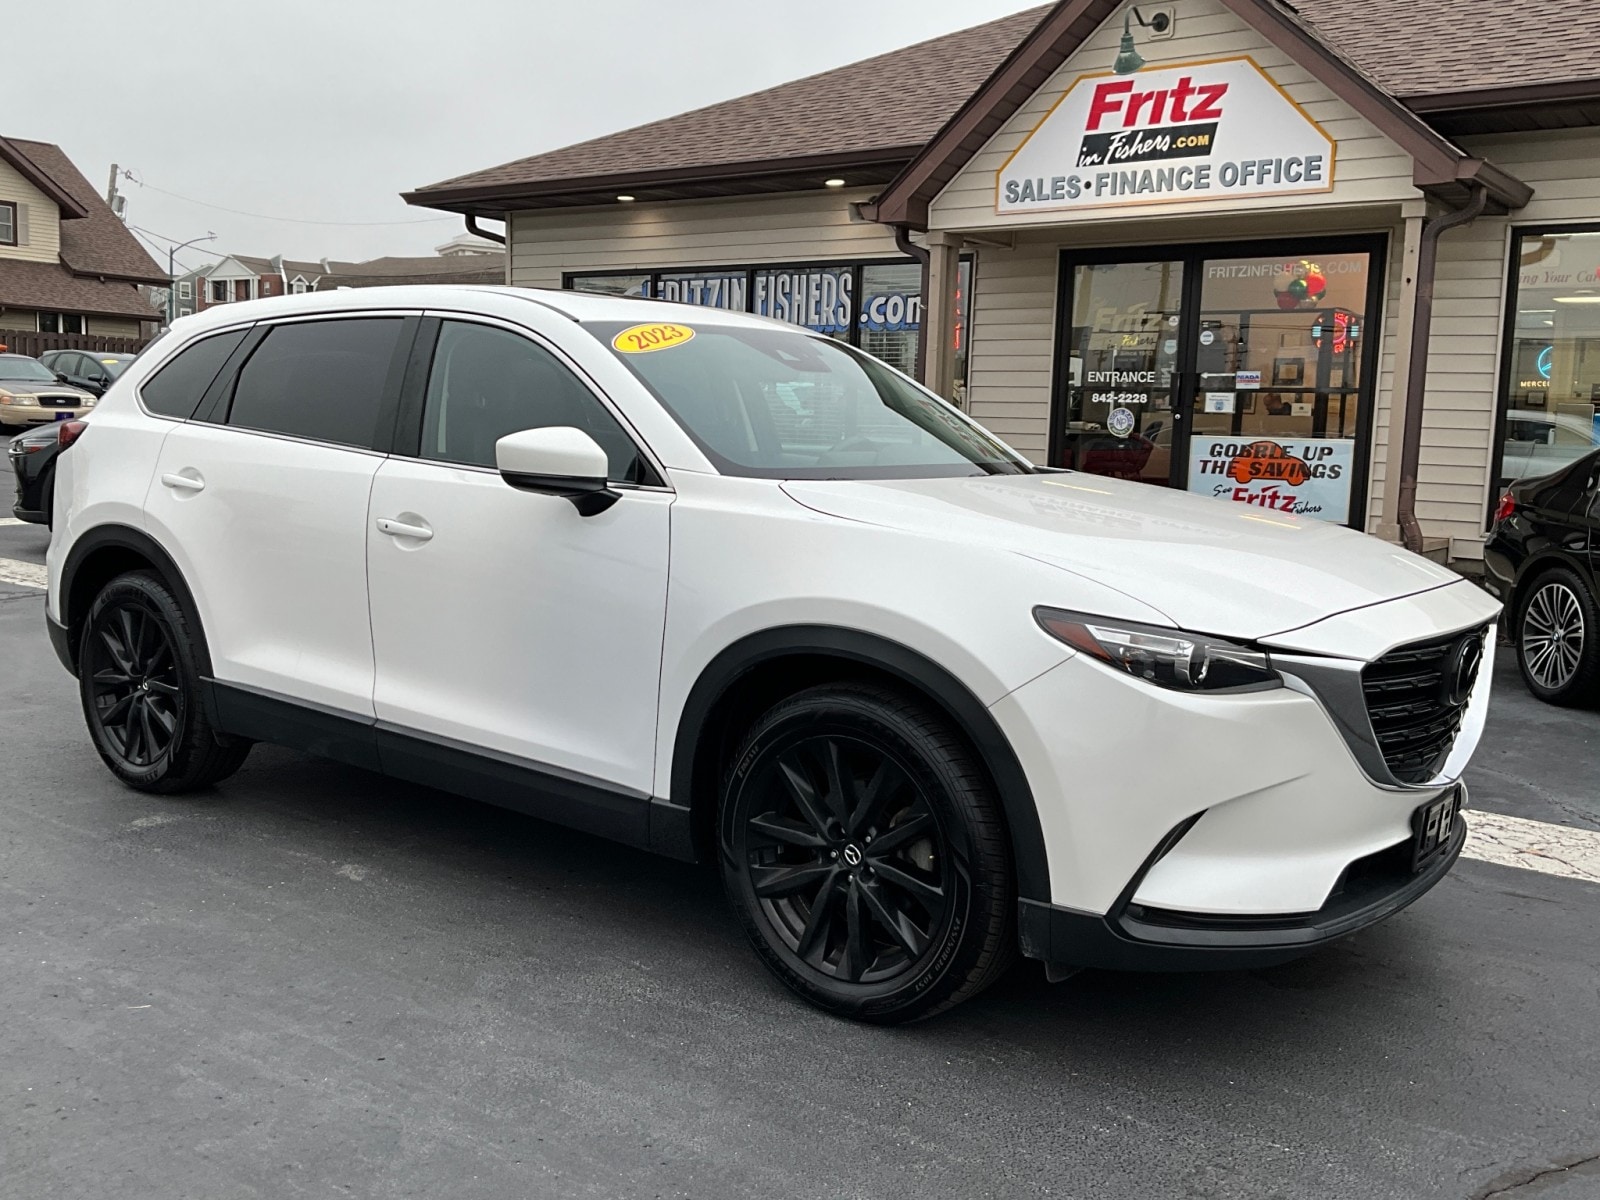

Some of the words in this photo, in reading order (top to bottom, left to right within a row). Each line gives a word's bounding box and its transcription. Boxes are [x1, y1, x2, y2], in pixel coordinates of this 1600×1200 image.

[1085, 76, 1229, 131] Fritz
[1079, 146, 1101, 166] in
[1005, 174, 1081, 203] SALES
[1095, 164, 1211, 197] FINANCE
[1218, 155, 1323, 187] OFFICE
[1208, 260, 1361, 279] FRITZINFISHES.COM
[1543, 270, 1572, 284] Your
[628, 325, 683, 349] 2023
[1088, 371, 1156, 383] ENTRANCE
[1092, 393, 1148, 404] 842-2228
[1209, 443, 1294, 460] GOBBLE
[1302, 446, 1334, 461] UP
[1200, 459, 1240, 475] THE
[1248, 461, 1342, 480] SAVINGS
[1232, 485, 1298, 513] Fritz
